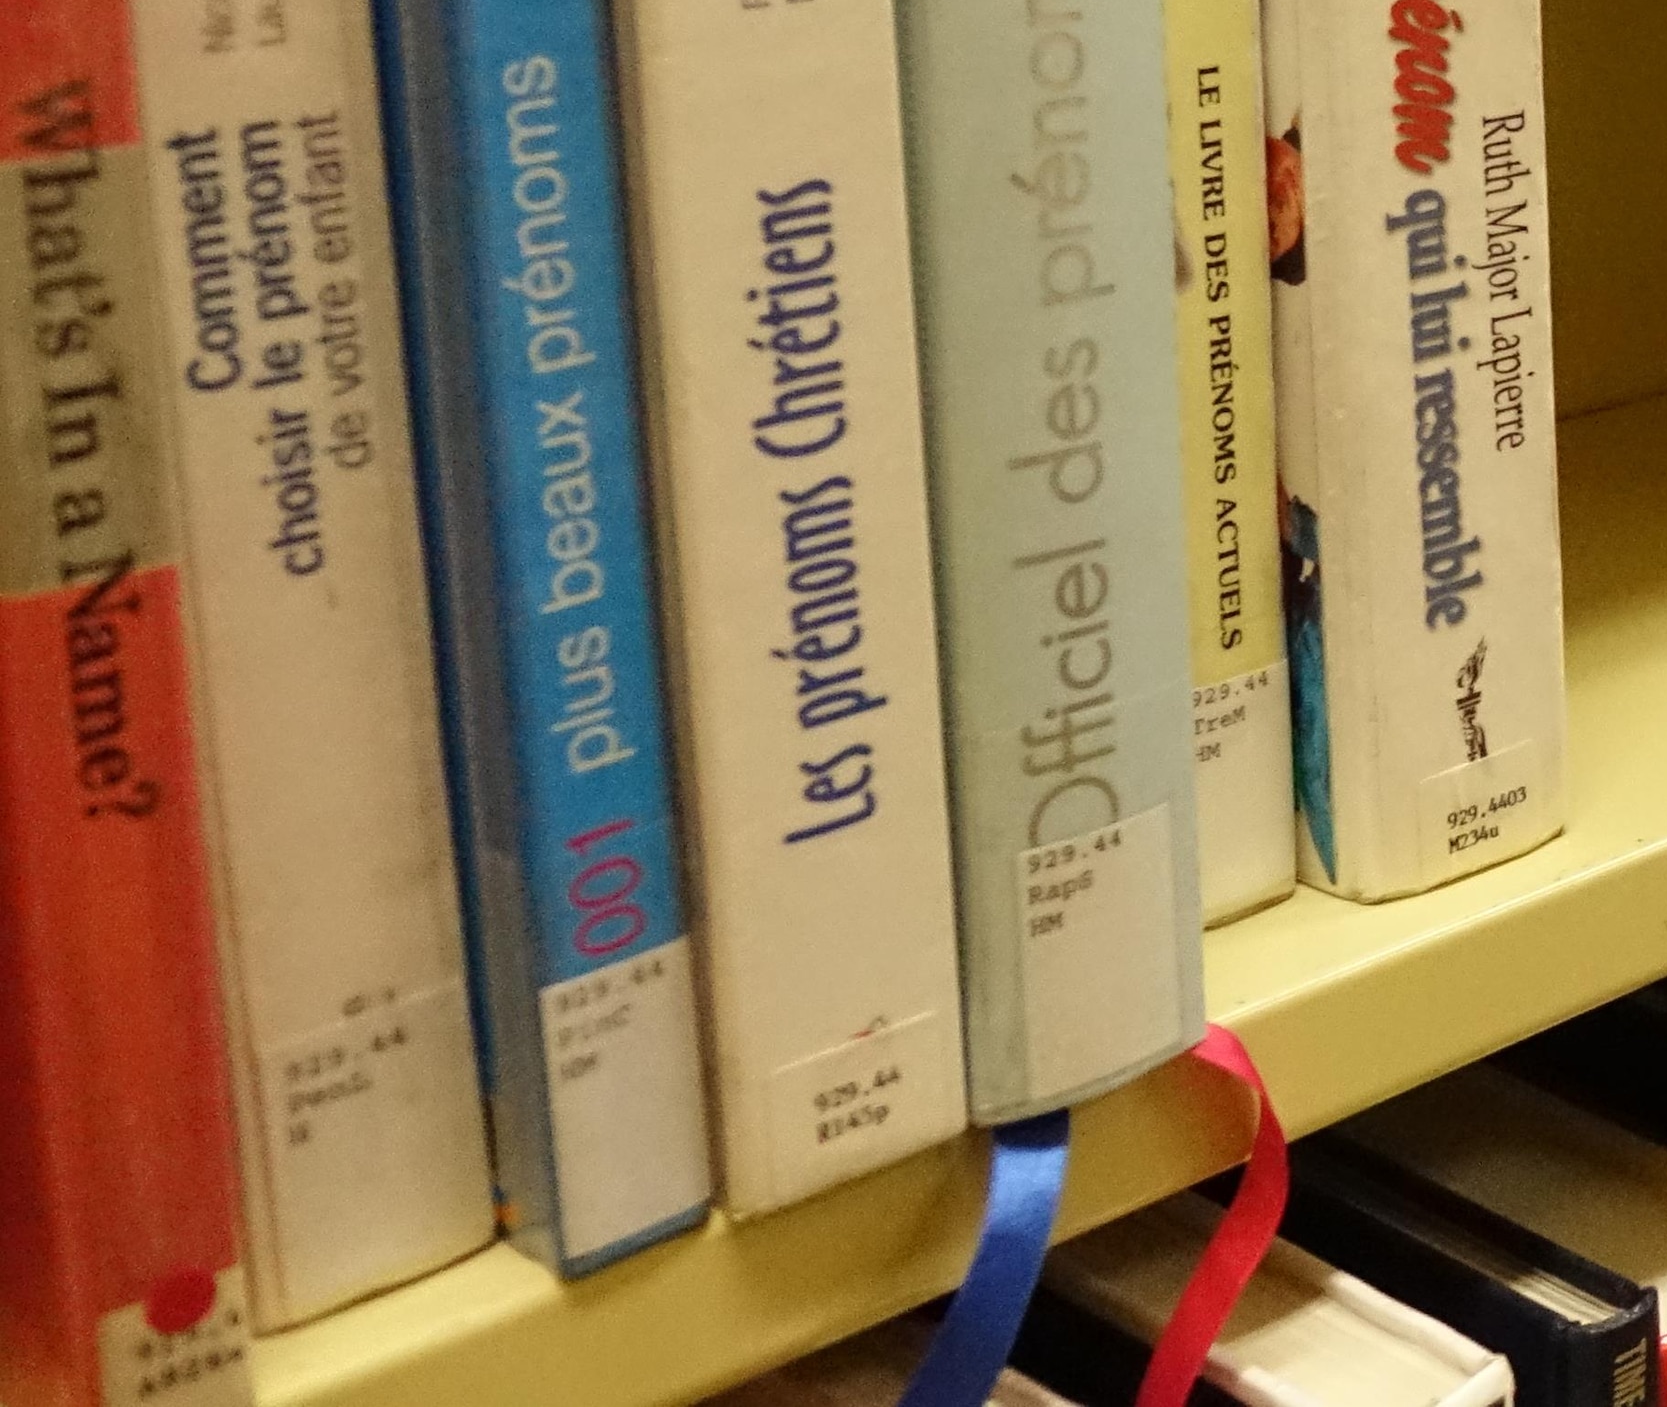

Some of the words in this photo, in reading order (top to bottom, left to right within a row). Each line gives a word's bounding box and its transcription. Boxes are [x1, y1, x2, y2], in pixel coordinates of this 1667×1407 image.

[1197, 65, 1221, 103] LE
[1481, 107, 1528, 198] Ruth
[16, 78, 117, 357] What's
[237, 116, 311, 322] prénom
[297, 108, 353, 269] enfant
[502, 52, 598, 377] prénoms
[1197, 114, 1226, 222] LIVRE
[1385, 187, 1468, 280] qui
[165, 125, 247, 393] Comment
[745, 176, 852, 462] Chrétiens
[1203, 231, 1231, 305] DES
[1409, 288, 1471, 362] lui
[1482, 200, 1535, 302] Major
[254, 336, 305, 388] le
[311, 278, 362, 408] votre
[1006, 332, 1104, 504] des
[1206, 311, 1238, 485] PRÉNOMS
[1475, 308, 1529, 454] Lapierre
[43, 374, 122, 465] In
[271, 404, 325, 578] choisir
[320, 412, 370, 472] de
[536, 388, 606, 616] beaux
[1214, 495, 1243, 651] ACTUELS
[1410, 368, 1486, 634] ressemble
[768, 472, 888, 733] prénoms
[60, 547, 162, 822] Name?
[550, 624, 640, 775] plus
[1012, 535, 1121, 849] Officiel
[782, 741, 878, 848] Les
[1446, 785, 1528, 831] 929.4403
[564, 818, 650, 960] 001
